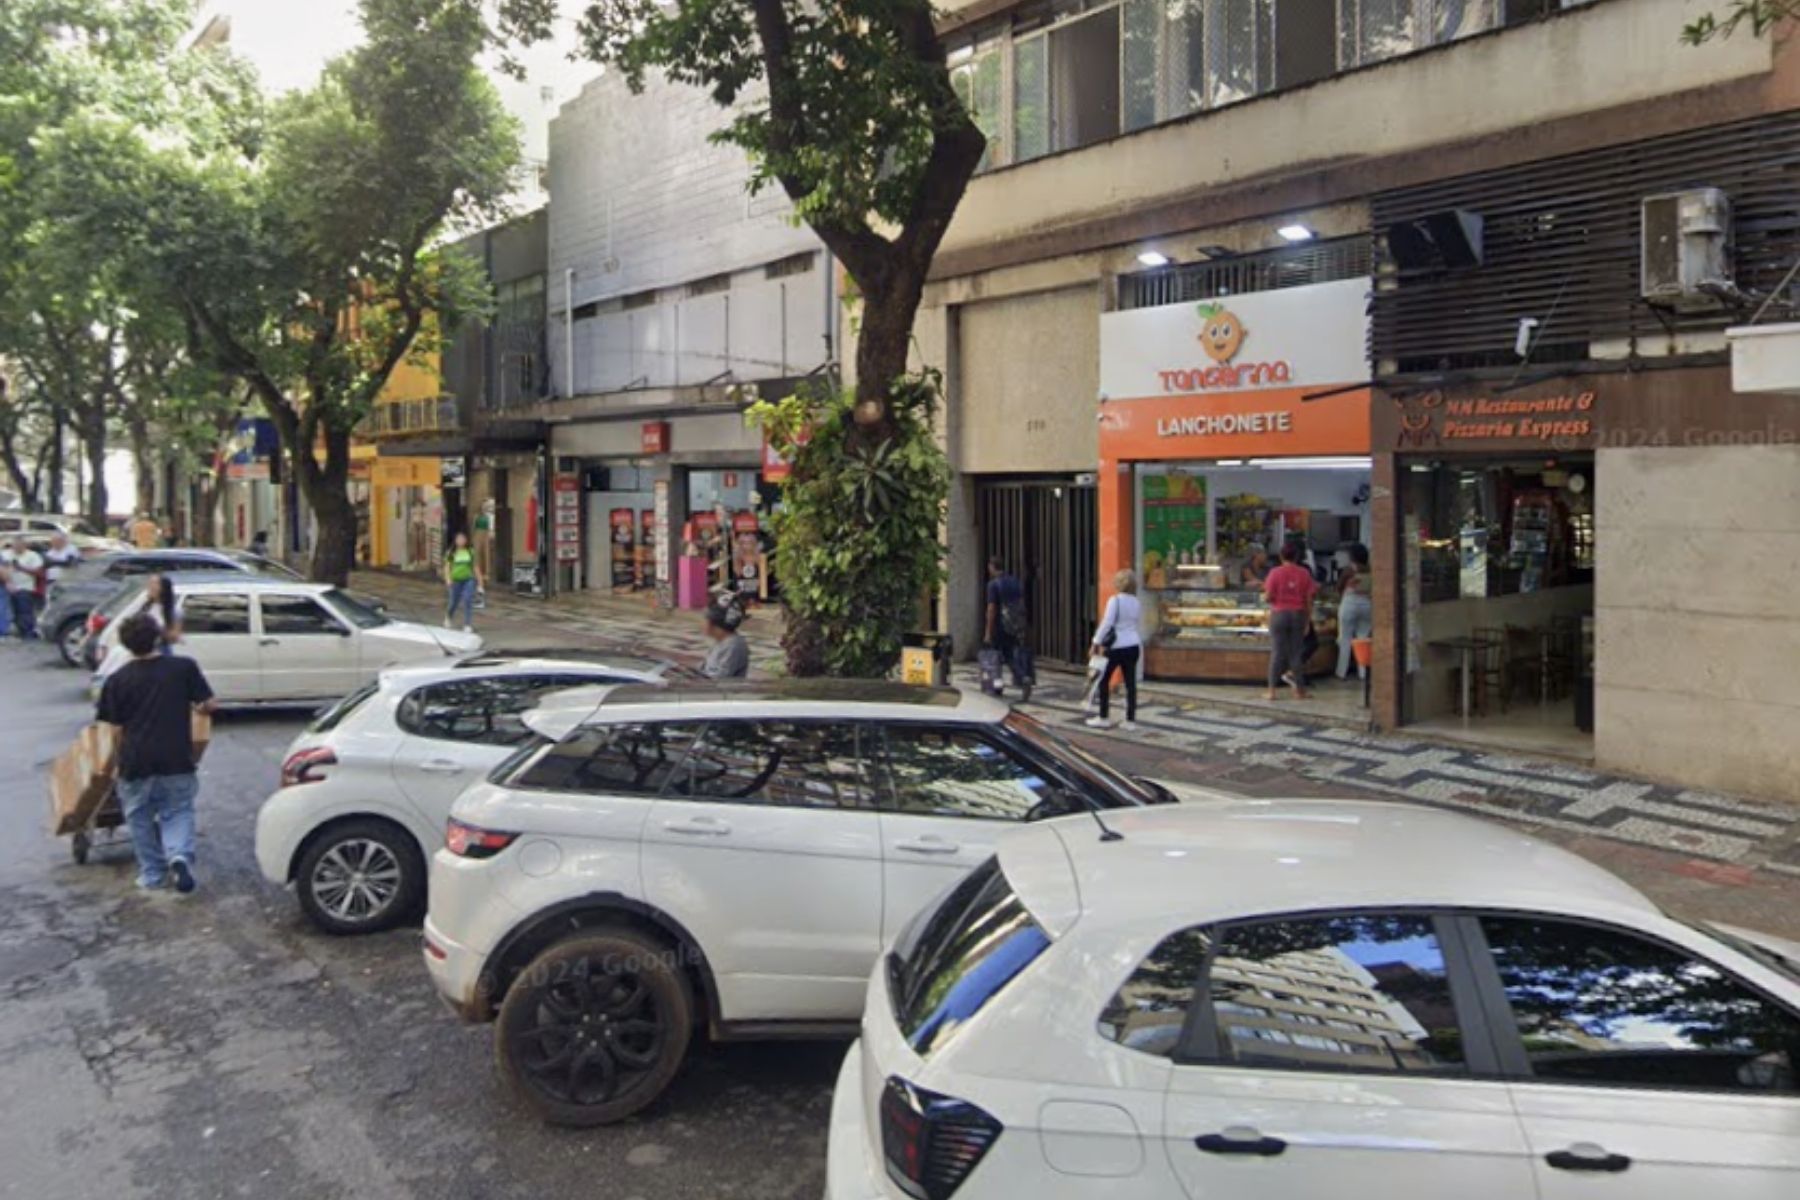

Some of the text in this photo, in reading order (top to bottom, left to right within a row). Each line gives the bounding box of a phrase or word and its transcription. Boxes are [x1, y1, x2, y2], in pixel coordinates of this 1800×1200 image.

[1475, 395, 1573, 415] Restaurante
[1157, 412, 1292, 437] LANCHONETE
[1518, 417, 1591, 440] Express
